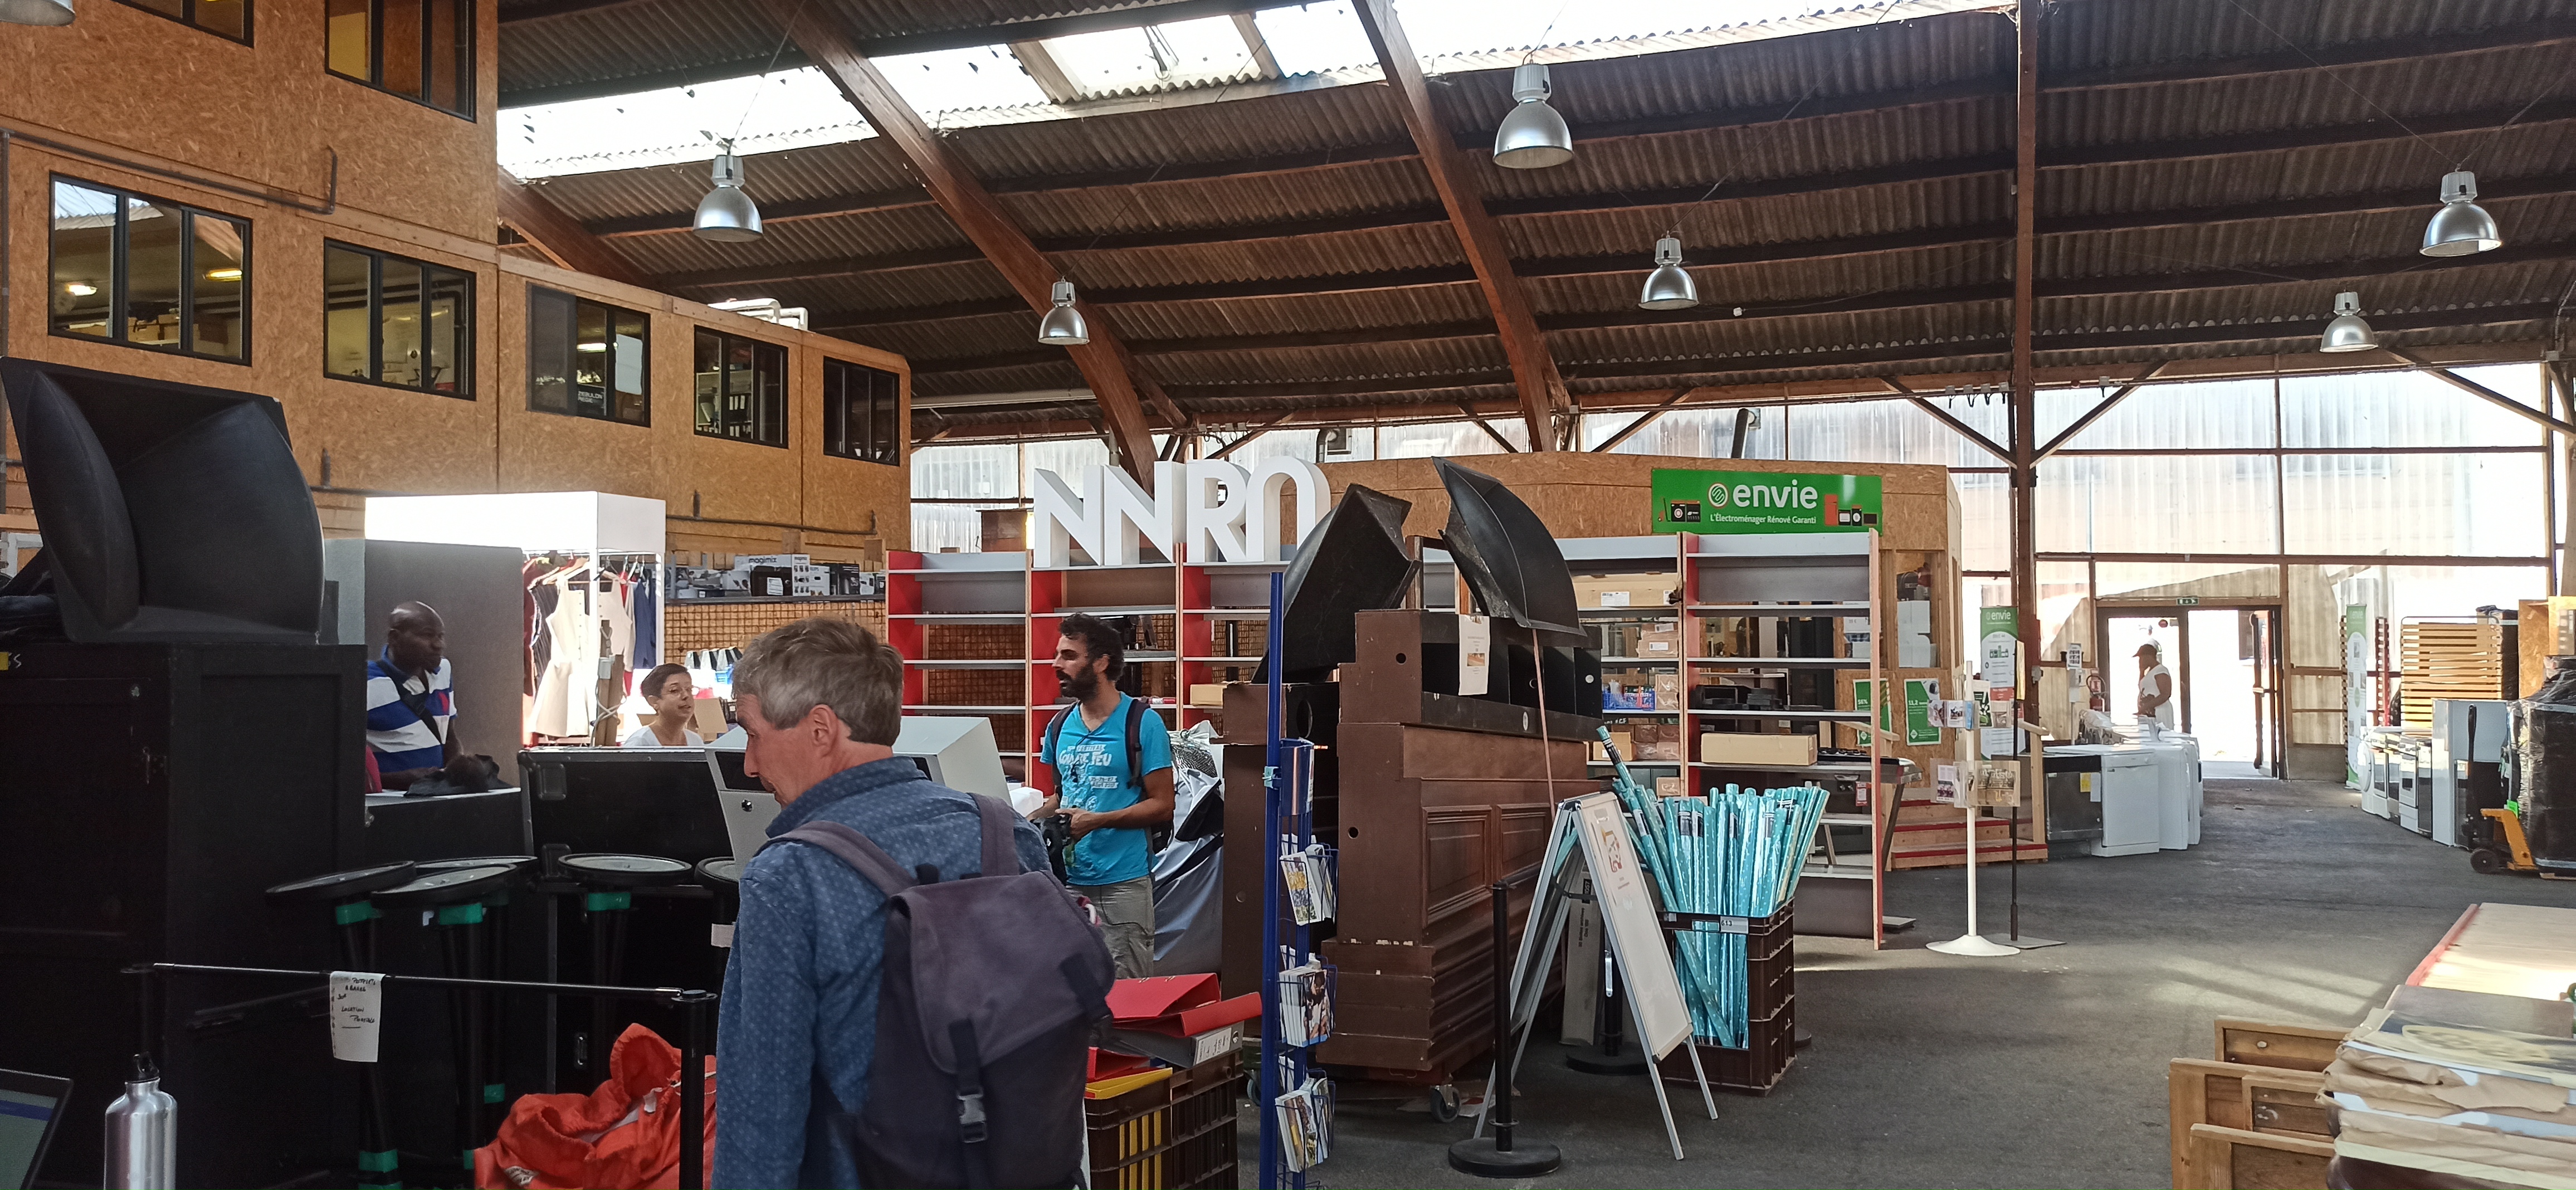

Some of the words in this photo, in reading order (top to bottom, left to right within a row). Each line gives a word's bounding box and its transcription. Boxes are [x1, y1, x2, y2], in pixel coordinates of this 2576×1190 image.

[1733, 479, 1818, 509] envie
[1710, 513, 1766, 525] L'Électroménager
[1767, 515, 1790, 524] Rénové
[1792, 516, 1817, 524] Garanti
[1991, 610, 2012, 620] envie
